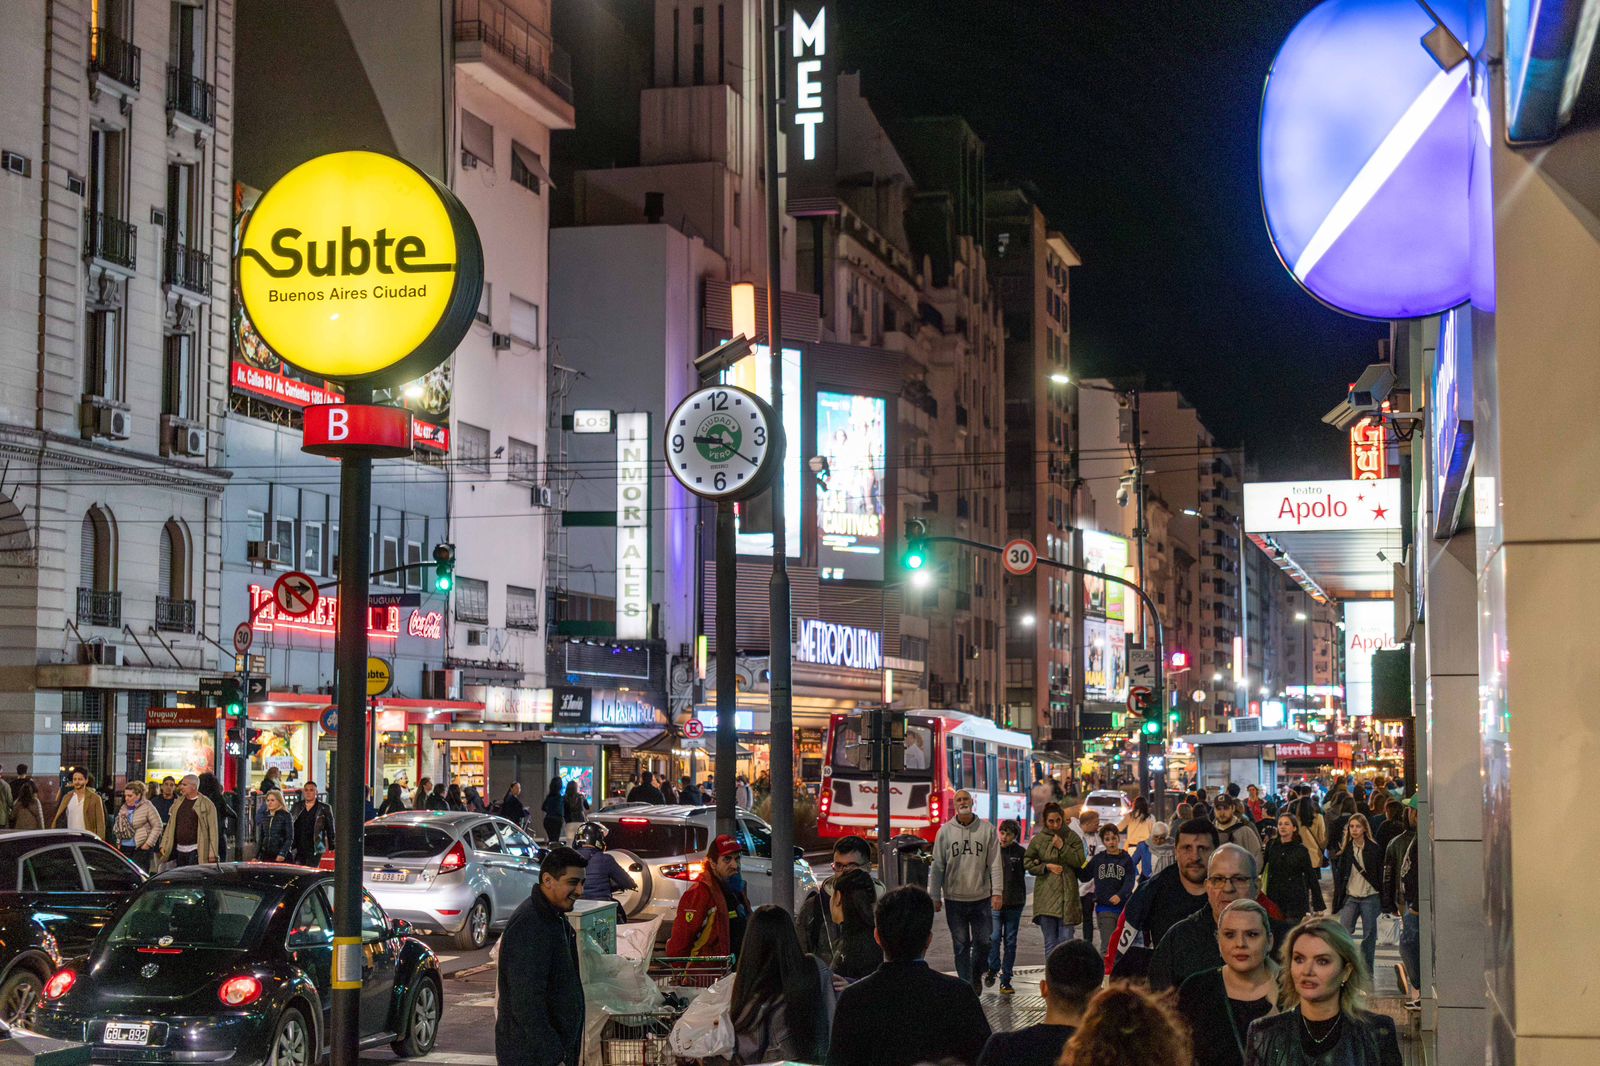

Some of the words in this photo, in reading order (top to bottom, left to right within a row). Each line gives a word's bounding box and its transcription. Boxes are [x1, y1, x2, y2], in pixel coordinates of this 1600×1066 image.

[793, 5, 826, 160] MET
[245, 226, 457, 278] Subte
[268, 288, 325, 303] Buenos
[330, 287, 368, 300] Aires
[373, 284, 427, 299] Ciudad
[707, 391, 729, 412] 12
[328, 408, 350, 441] B
[575, 417, 609, 428] LOS
[702, 415, 731, 433] CIUDAD
[672, 434, 685, 454] 9
[753, 426, 766, 446] 3
[709, 447, 734, 460] VERD
[714, 471, 727, 491] 6
[1292, 486, 1322, 495] teatro
[1278, 494, 1347, 525] Apolo
[622, 429, 643, 618] INMORTALES
[1010, 549, 1029, 564] 30
[367, 596, 401, 605] RUGUAY
[237, 631, 249, 644] 30
[799, 619, 880, 670] METROPOLITAN
[1351, 632, 1398, 654] Apolo
[148, 710, 178, 720] Uruguay
[951, 841, 984, 858] GAP
[1098, 863, 1126, 880] GAP
[106, 1027, 123, 1040] GBL
[128, 1028, 147, 1041] 892
